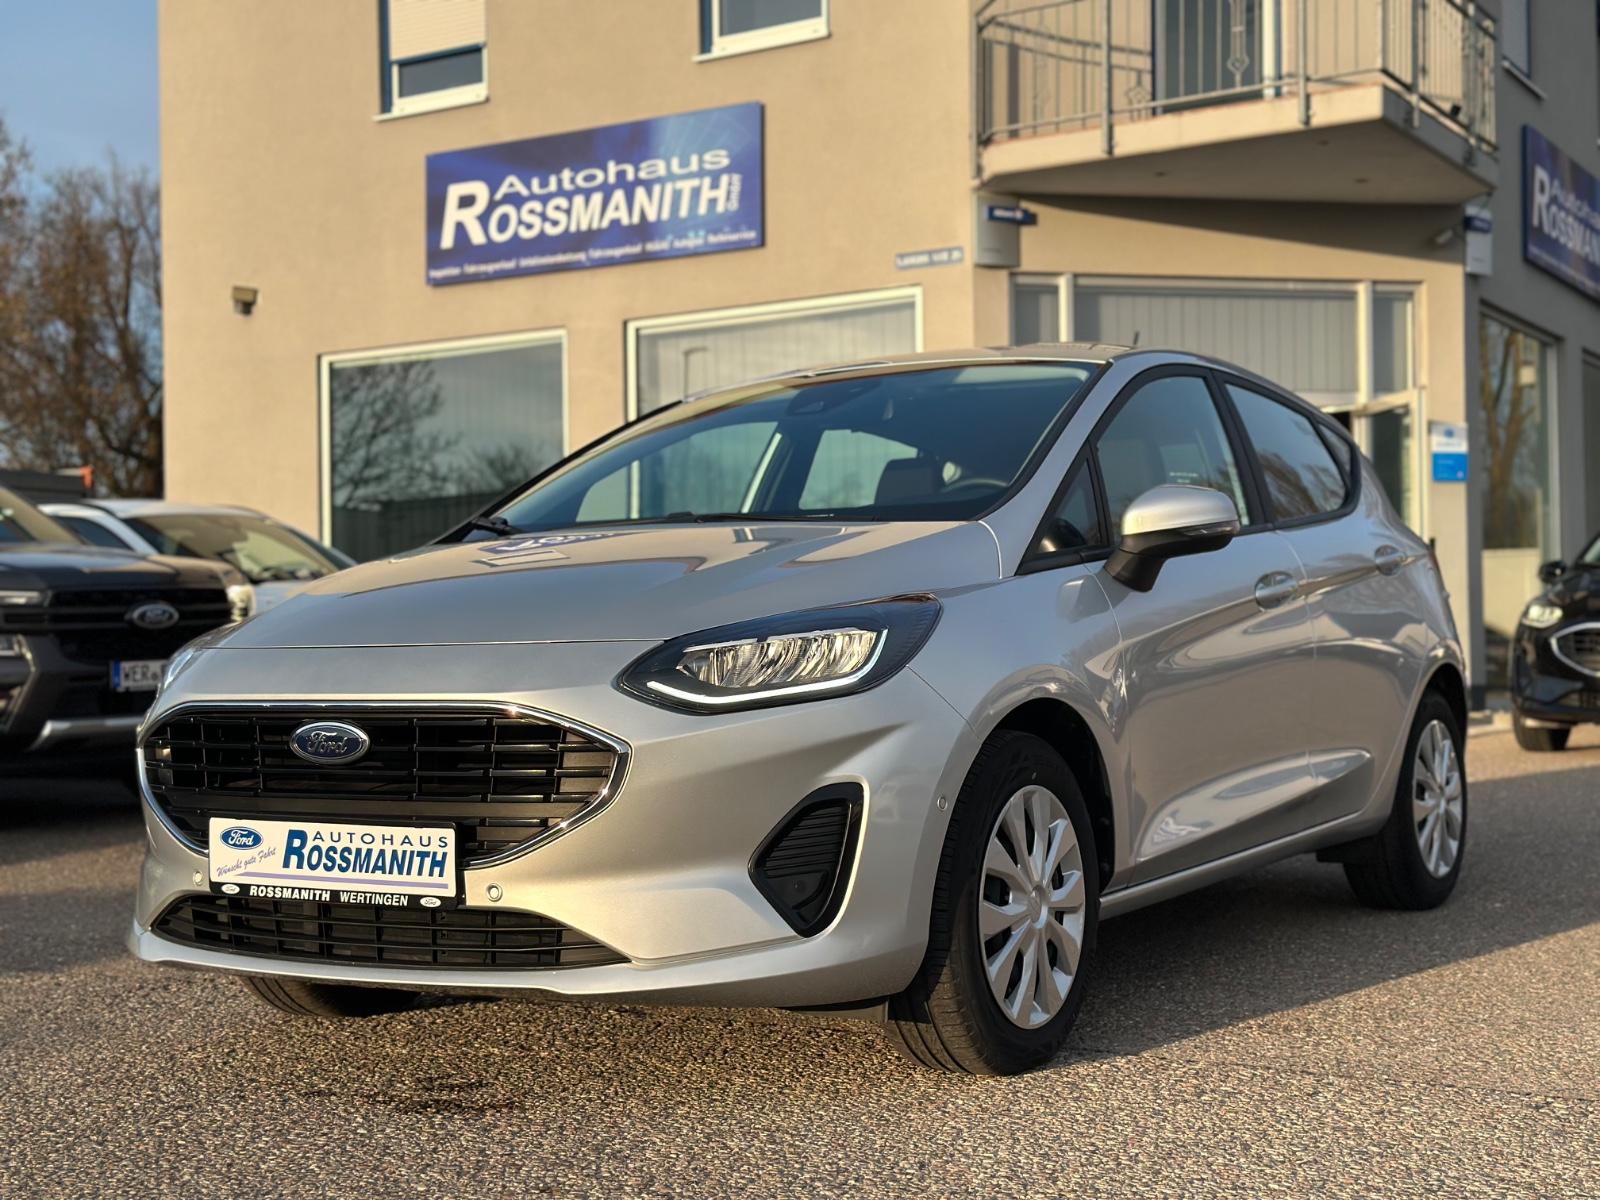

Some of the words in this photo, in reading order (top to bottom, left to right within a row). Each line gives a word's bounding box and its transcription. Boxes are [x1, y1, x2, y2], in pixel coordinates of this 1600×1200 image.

[494, 149, 731, 201] Autohaus
[440, 173, 729, 250] ROSSMANITH
[306, 730, 348, 753] Ford
[228, 829, 254, 846] Ford
[312, 830, 448, 848] AUTOHAUS
[257, 847, 276, 863] Fahrt
[282, 829, 448, 878] ROSSMANITH
[249, 885, 331, 901] ROSSMANITH
[339, 891, 409, 906] WERTINGEN
